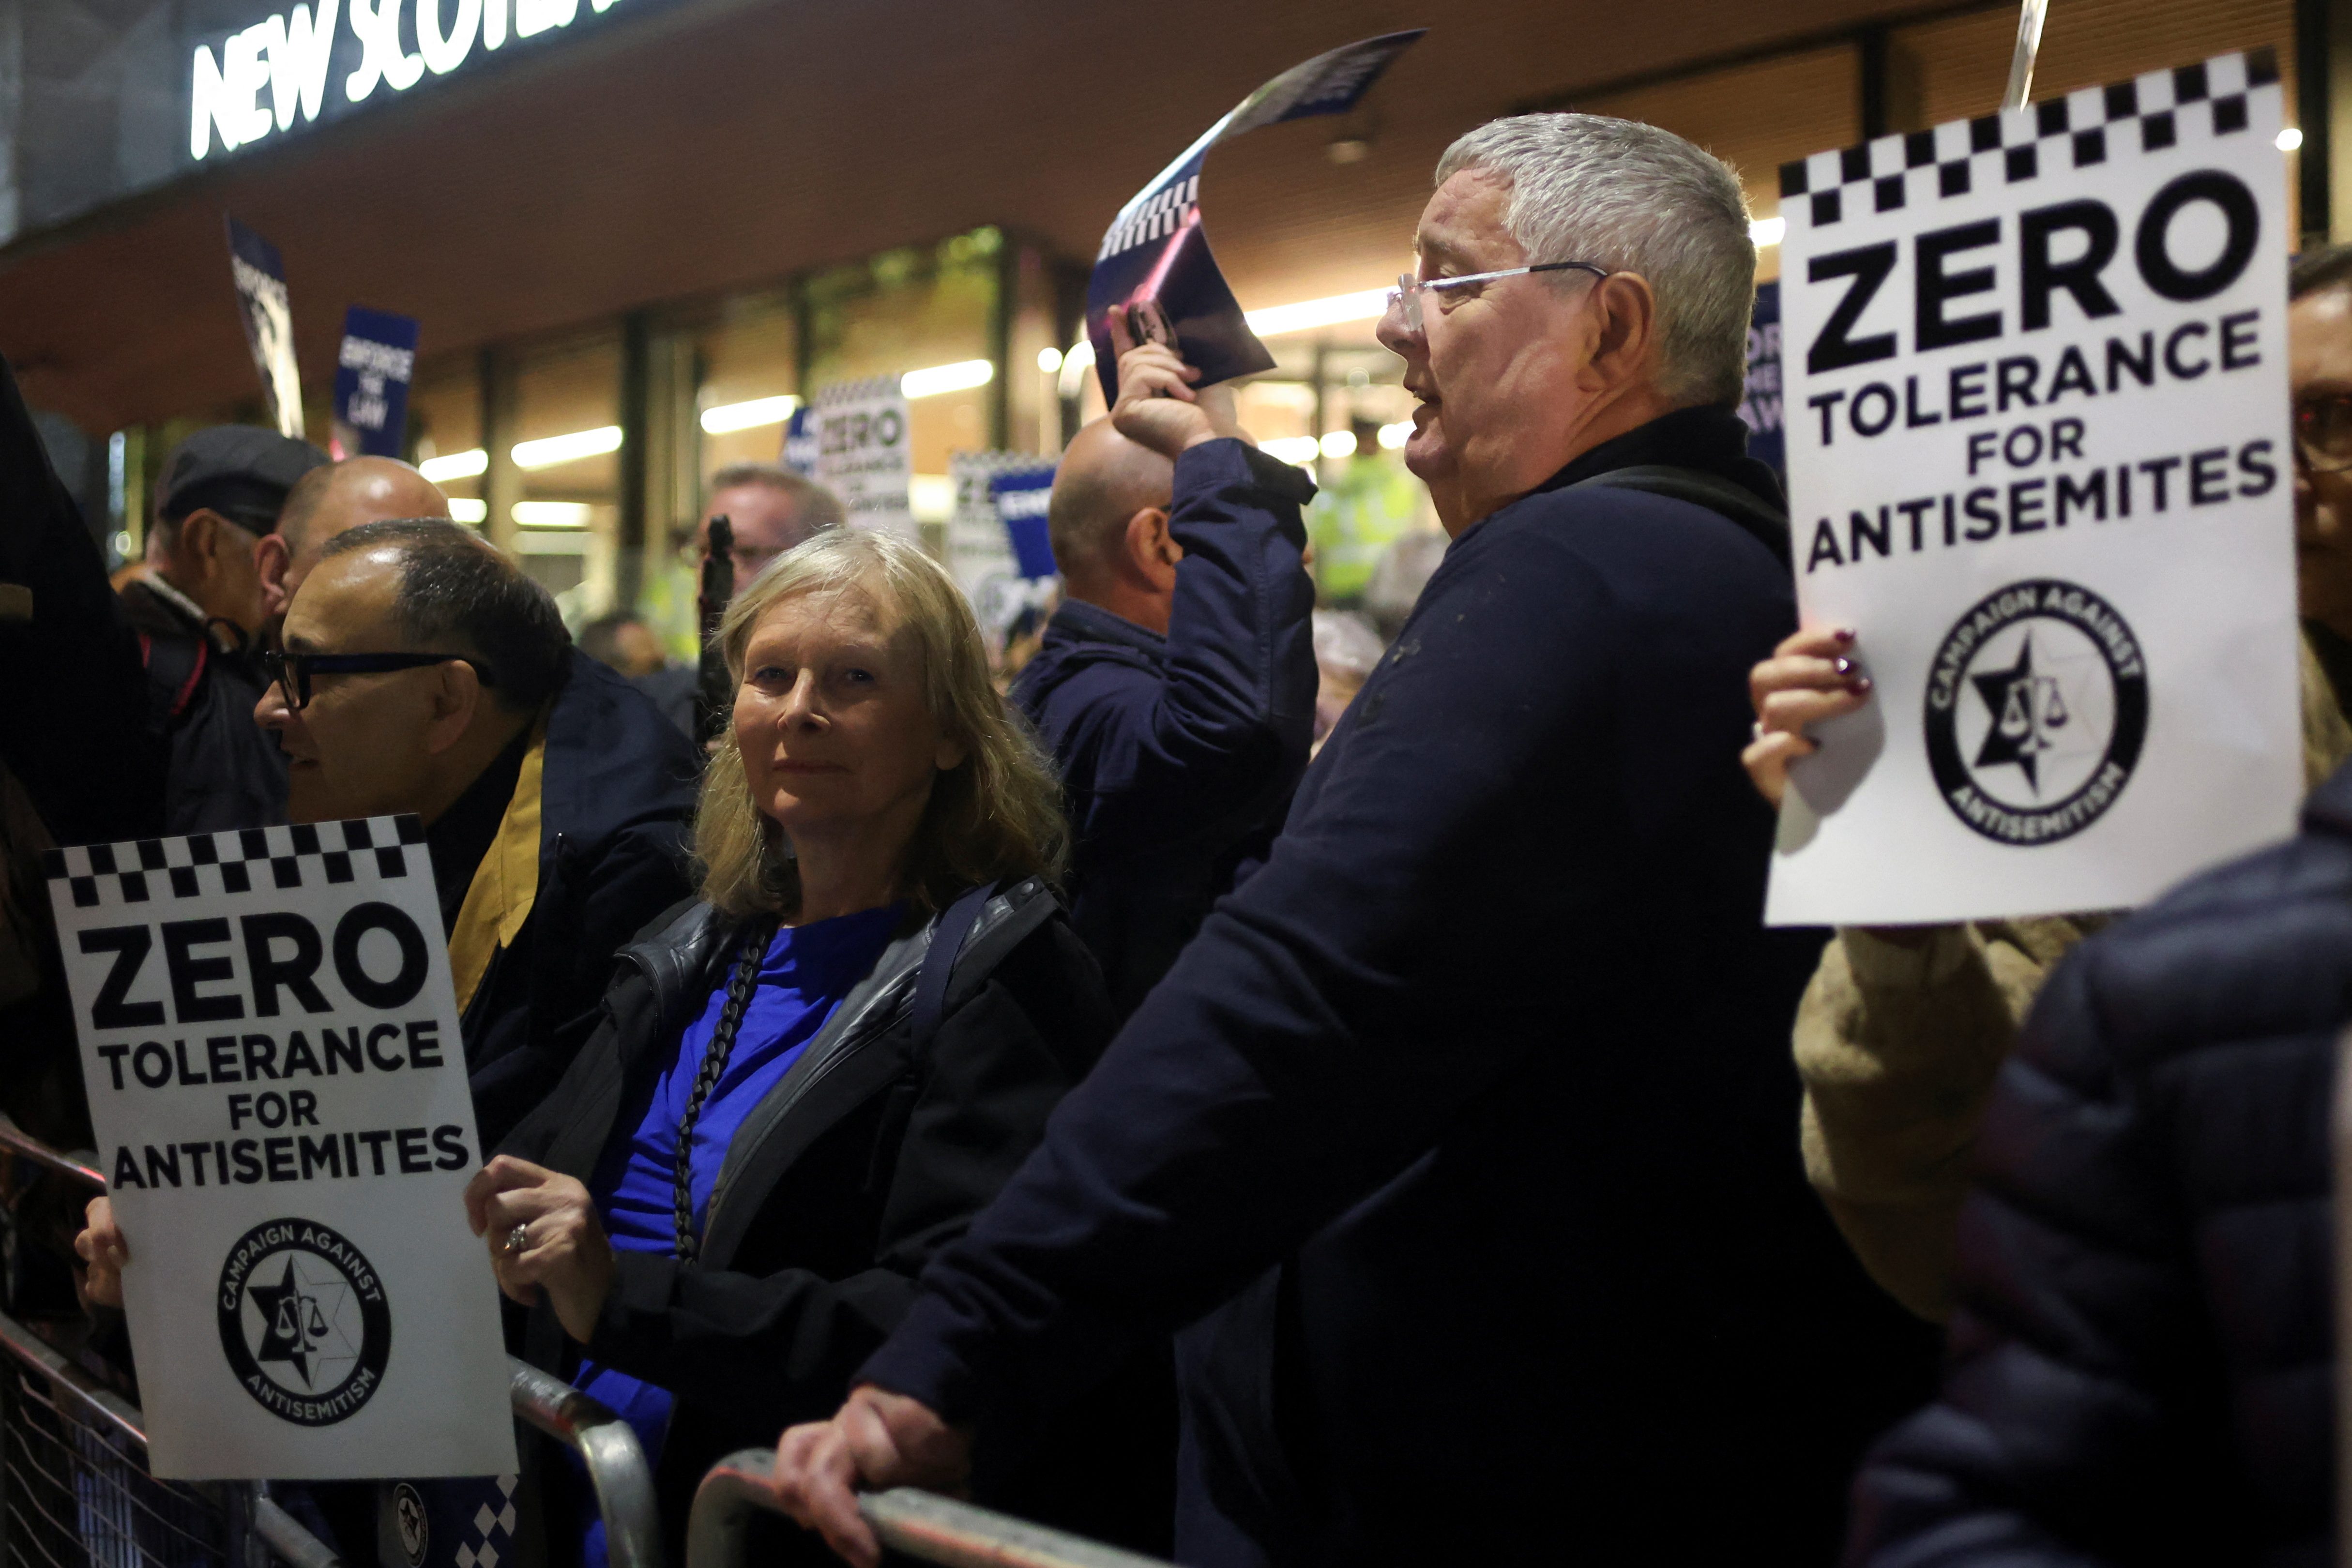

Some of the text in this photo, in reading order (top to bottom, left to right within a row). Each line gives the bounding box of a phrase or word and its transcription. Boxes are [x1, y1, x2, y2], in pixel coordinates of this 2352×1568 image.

[191, 0, 340, 160] NEW
[1807, 169, 2260, 375] ZERO
[1807, 310, 2261, 446] TOLERANCE
[1968, 417, 2085, 476] FOR
[1807, 440, 2277, 573] ANTISEMITES
[1931, 586, 2142, 710] CAMPAIGN AGAINST
[77, 901, 429, 1031] ZERO
[97, 1020, 444, 1091] TOLERANCE
[113, 1125, 469, 1190] ANTISEMITES
[228, 1090, 320, 1131] FOR
[223, 1225, 381, 1310] CAMPAIGN AGAINST
[247, 1367, 376, 1420] ANTISEMITISM
